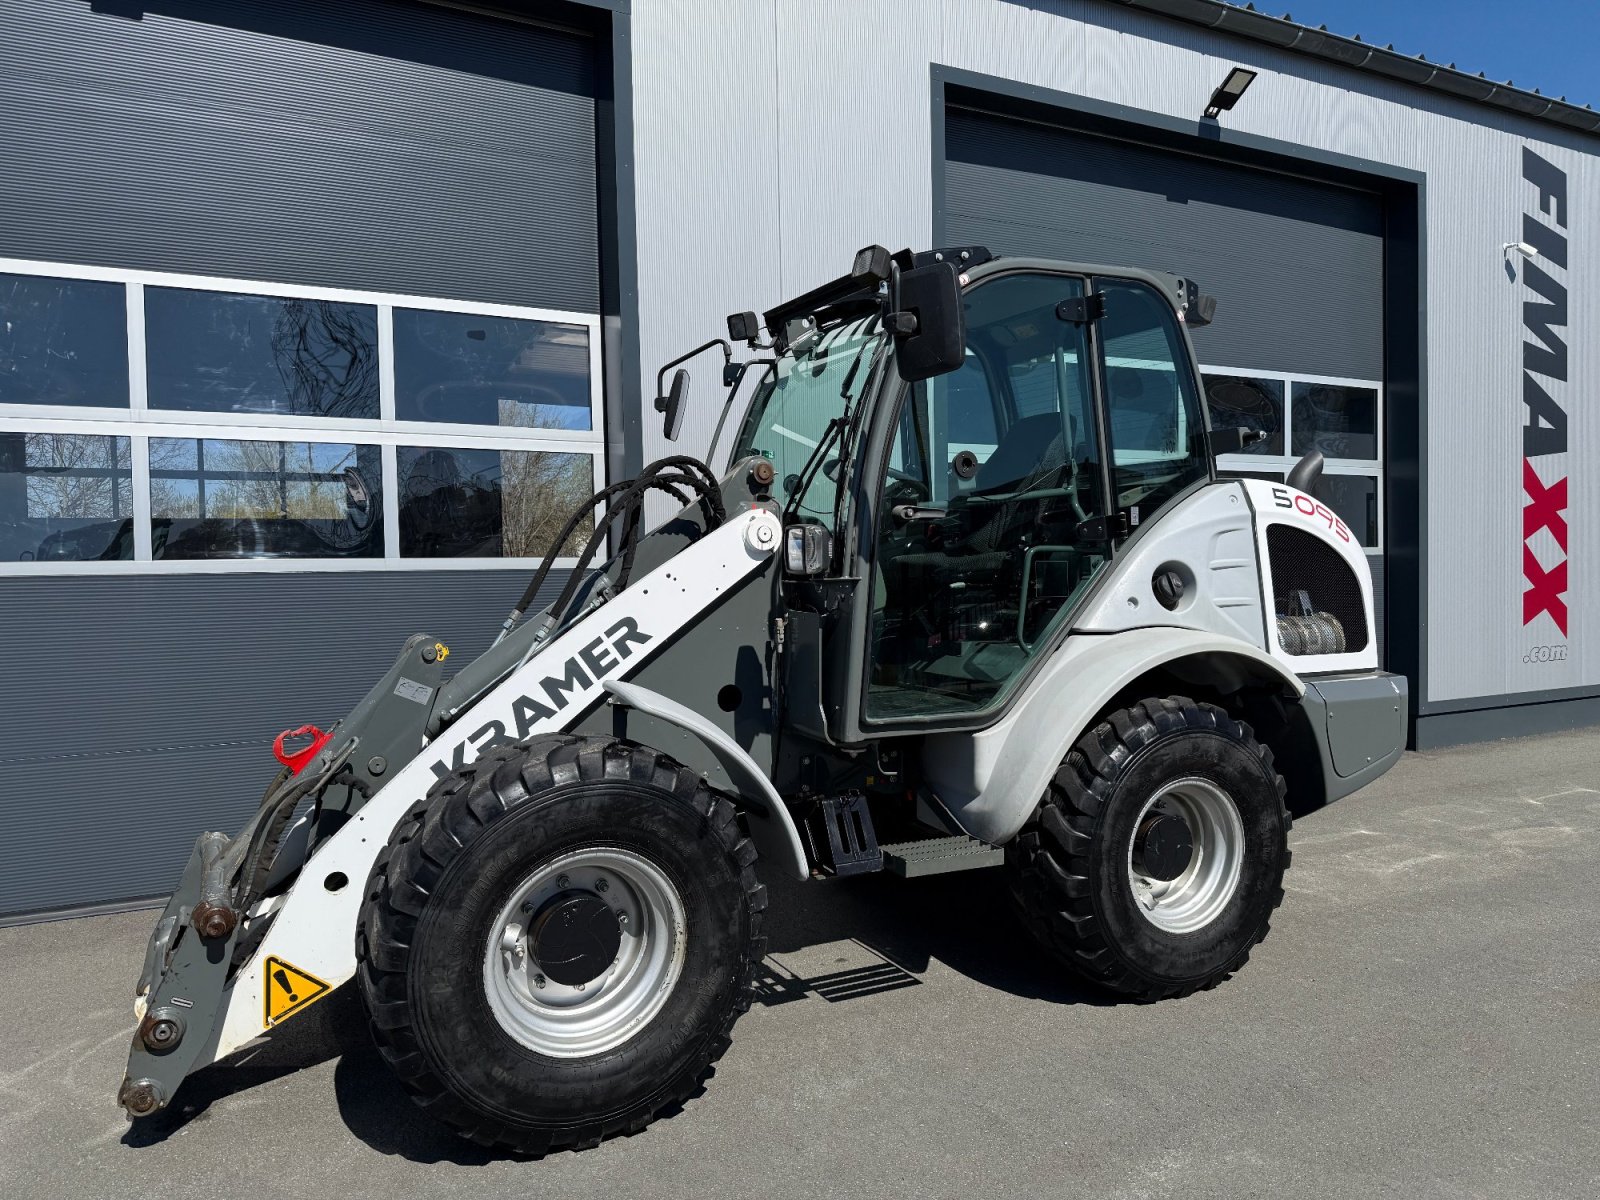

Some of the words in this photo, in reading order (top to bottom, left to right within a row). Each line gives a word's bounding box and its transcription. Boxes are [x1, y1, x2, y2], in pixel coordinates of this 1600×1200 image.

[1522, 145, 1567, 640] FIMAXX
[1272, 487, 1350, 543] 5095
[429, 616, 653, 778] KRAMER
[1523, 645, 1568, 663] .com
